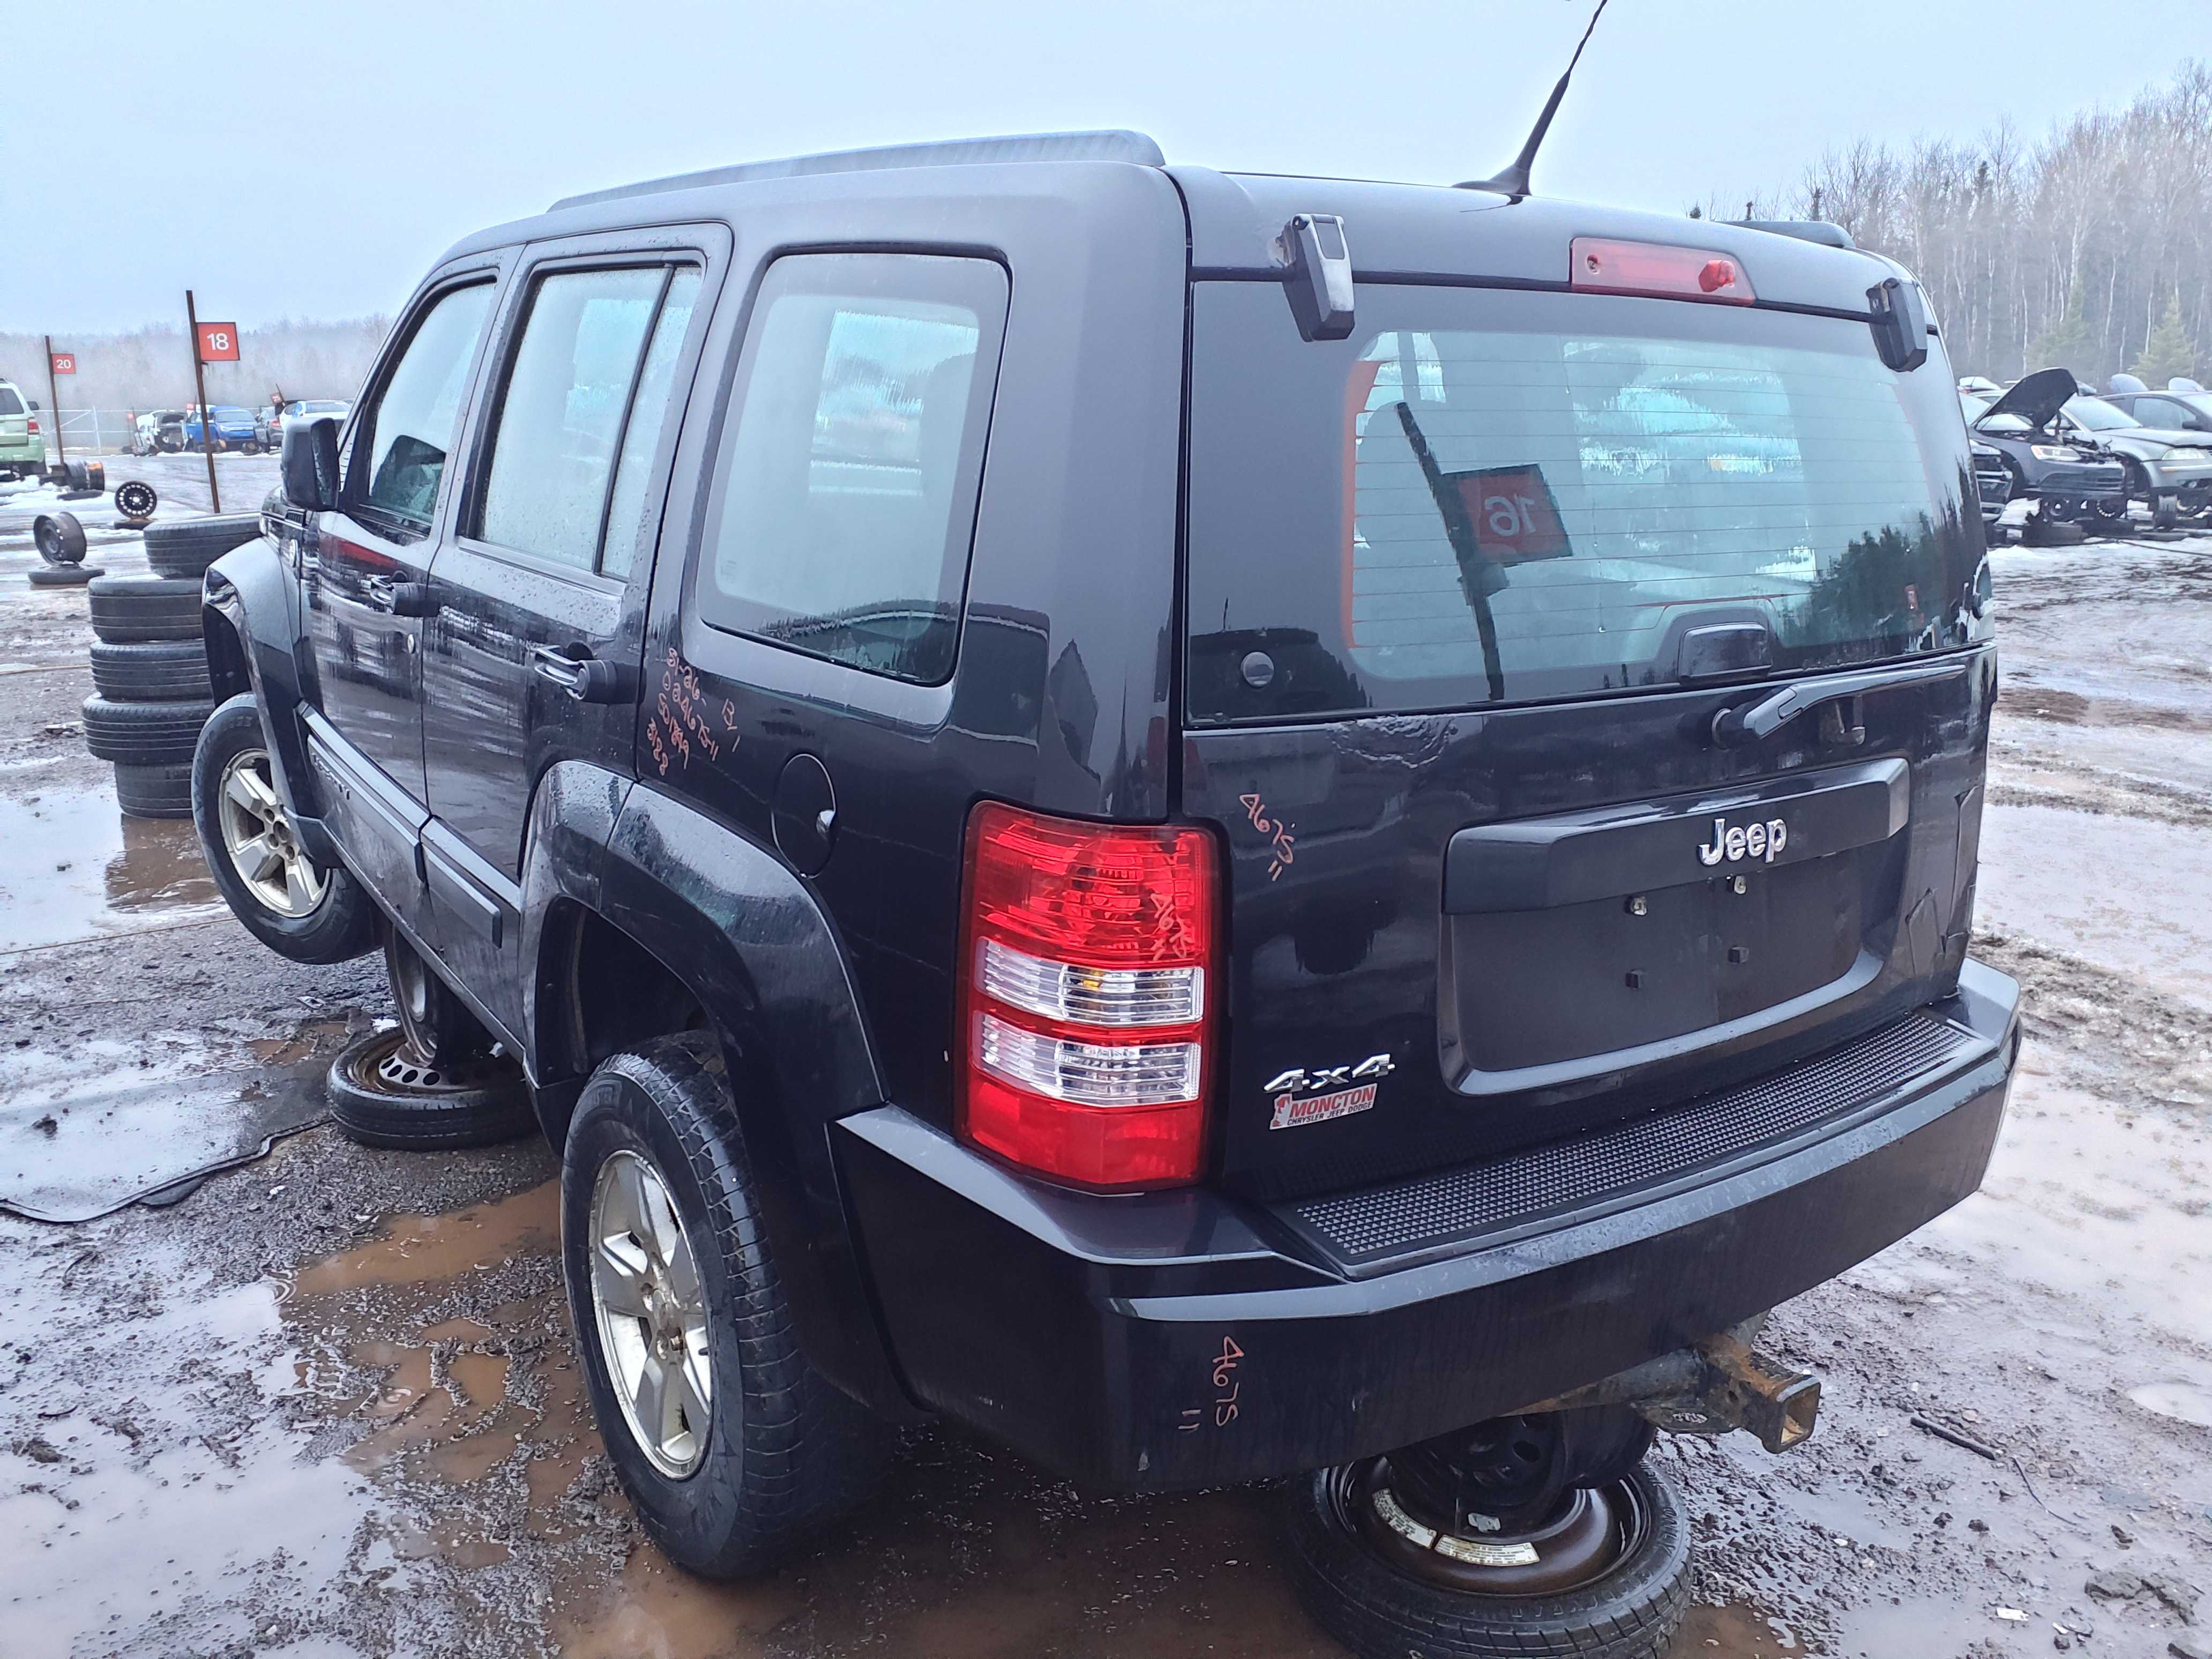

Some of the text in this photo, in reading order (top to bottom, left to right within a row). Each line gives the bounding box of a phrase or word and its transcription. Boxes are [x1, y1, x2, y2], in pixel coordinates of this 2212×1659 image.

[206, 332, 229, 351] 18
[56, 359, 71, 369] 20
[1239, 793, 1295, 864] 4675
[1698, 818, 1788, 867] Jeep
[1287, 1101, 1373, 1126] CHRYSLER JEEP DODGE
[1289, 1086, 1376, 1118] MONCTON
